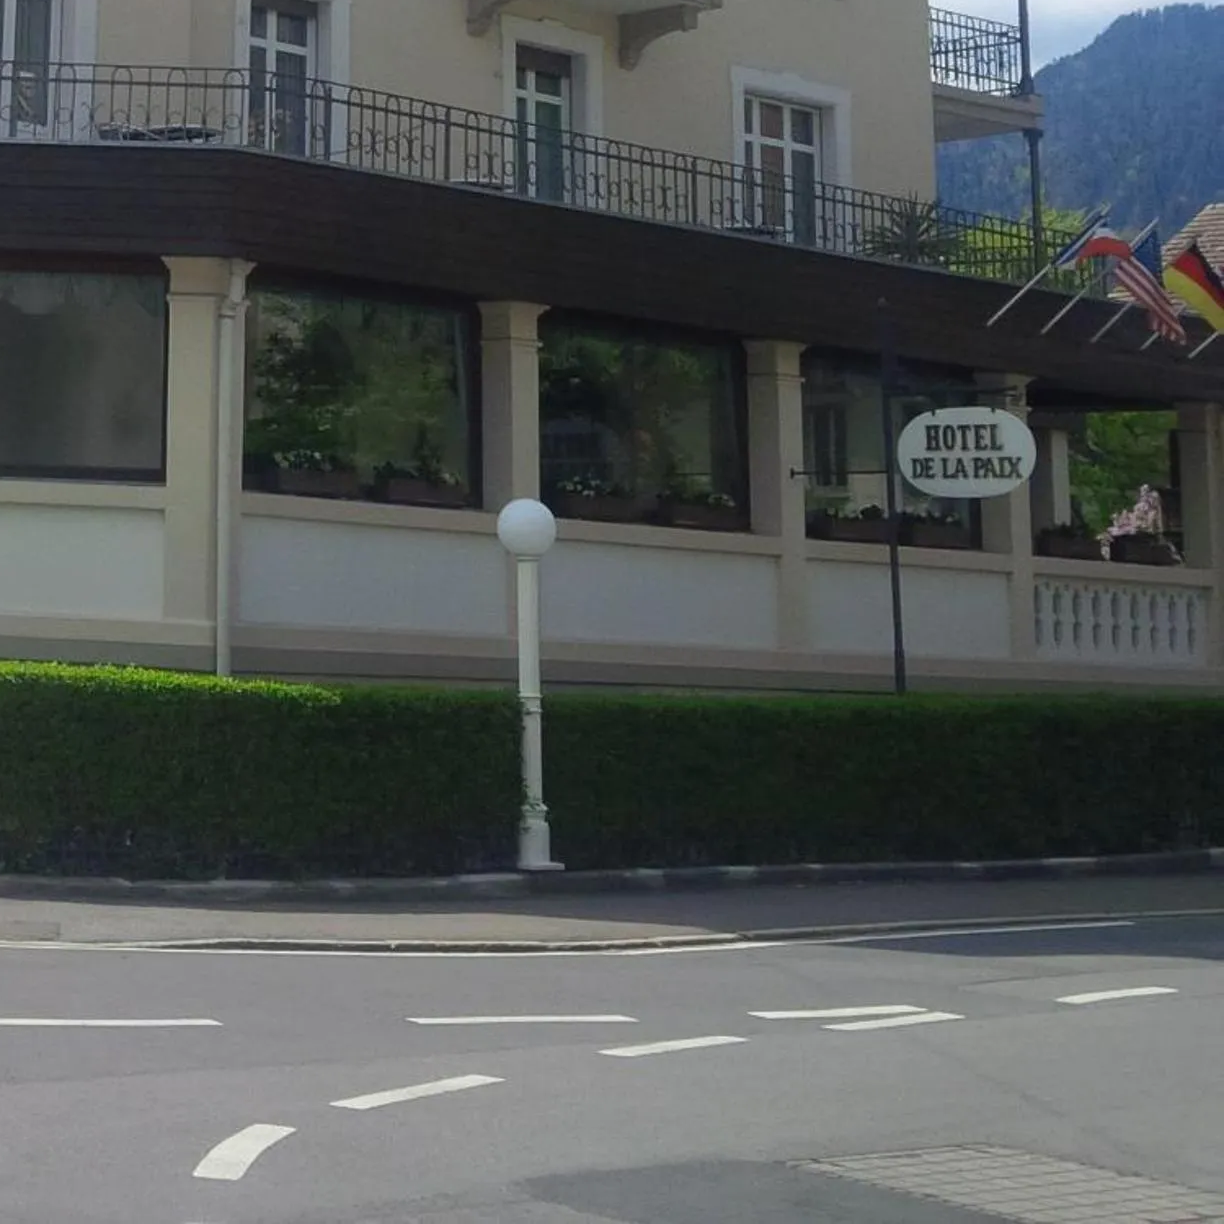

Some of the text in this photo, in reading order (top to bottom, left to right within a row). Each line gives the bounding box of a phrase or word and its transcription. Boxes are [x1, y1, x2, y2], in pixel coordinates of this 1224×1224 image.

[925, 424, 1004, 451] HOTEL
[911, 456, 1022, 479] DE LA PAIX
